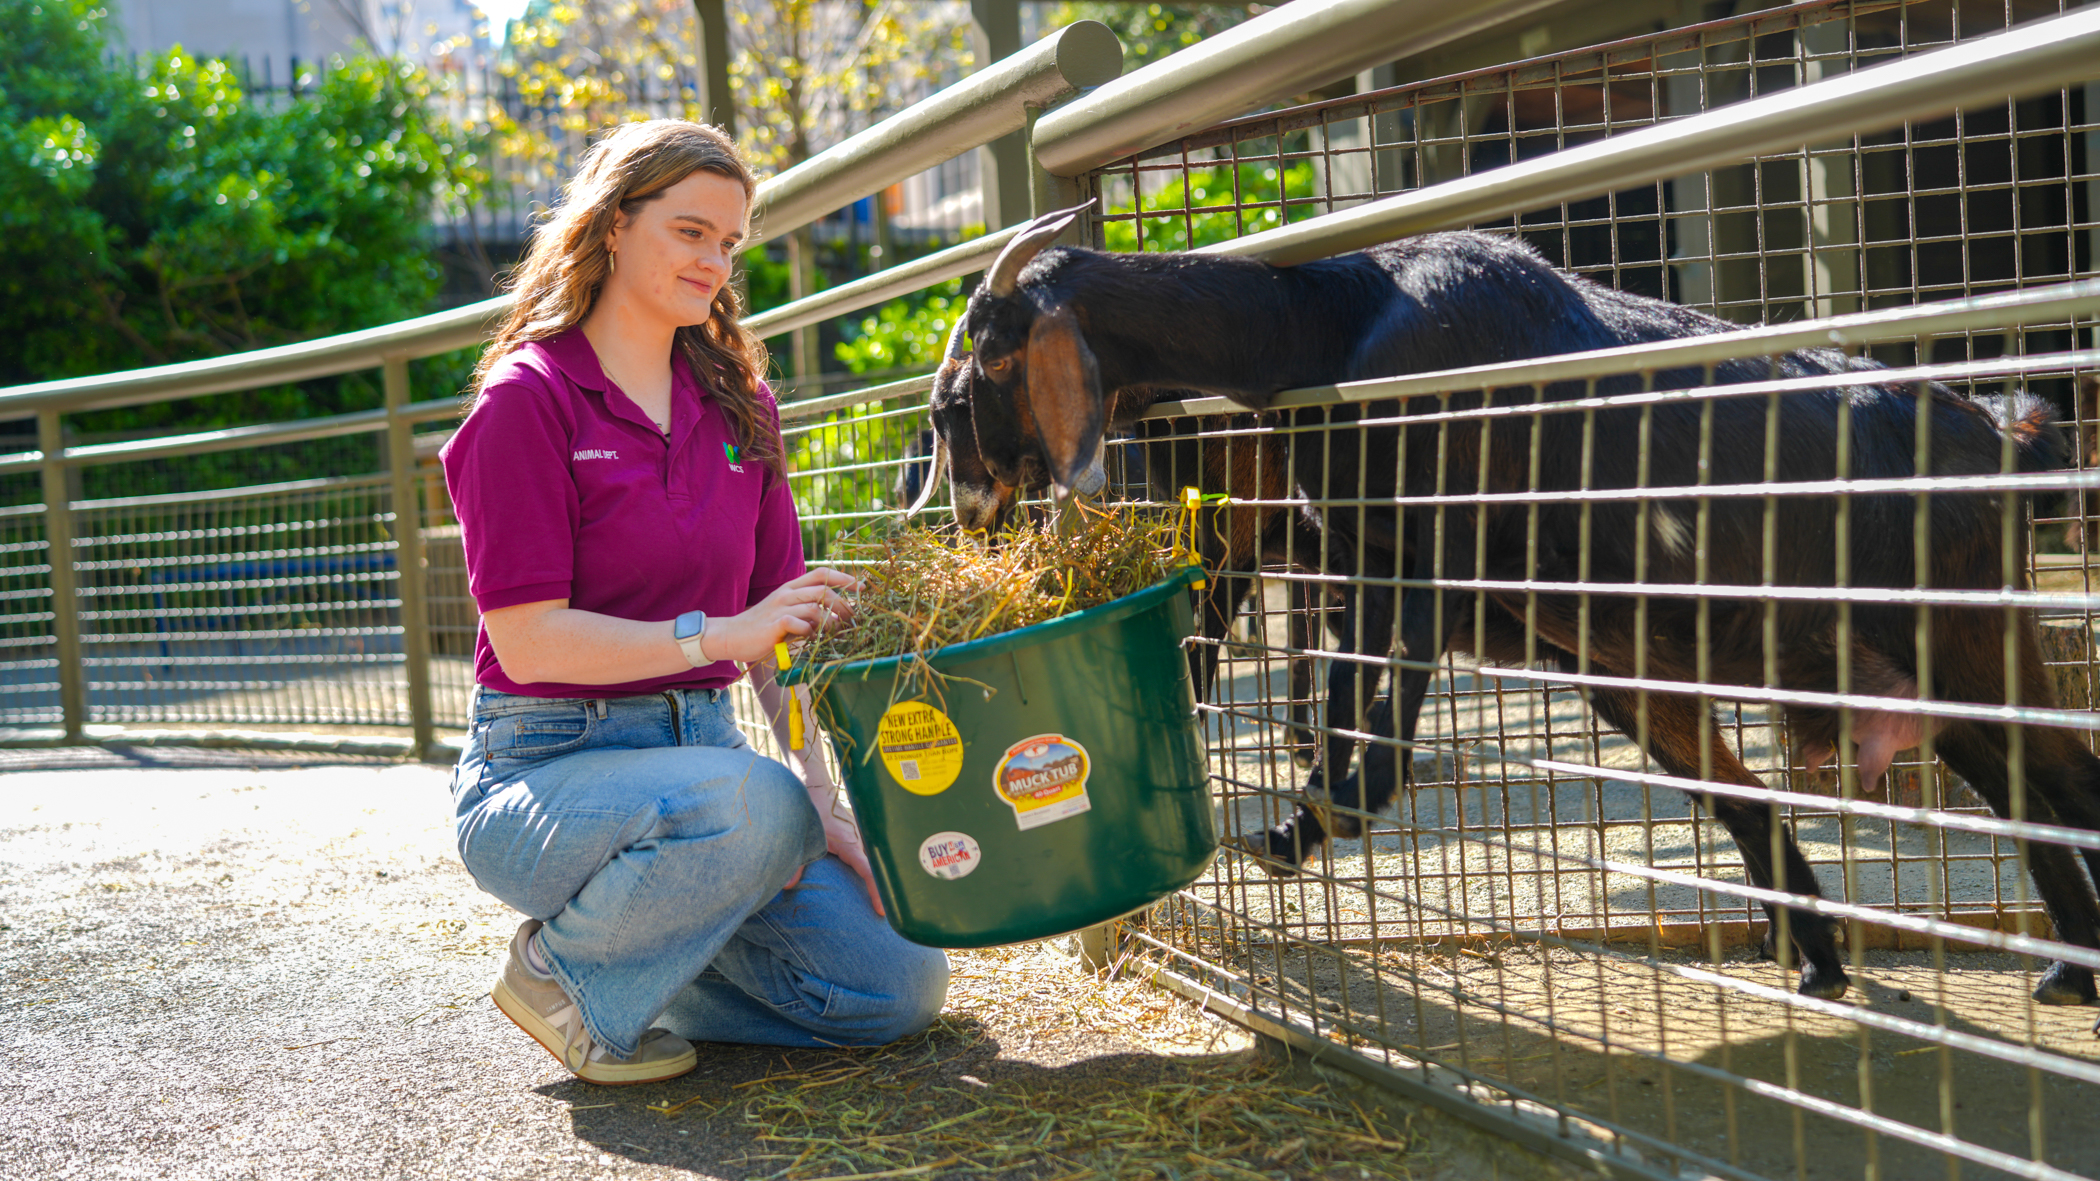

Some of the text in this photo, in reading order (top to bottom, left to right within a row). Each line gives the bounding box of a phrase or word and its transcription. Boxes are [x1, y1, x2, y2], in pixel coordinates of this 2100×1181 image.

[573, 449, 603, 461] ANIMAL
[728, 464, 744, 473] WCS
[887, 709, 935, 728] NEW EXTRA
[881, 728, 913, 744] STRONG
[1010, 773, 1050, 792] MUCK
[1050, 763, 1078, 780] TUB
[1044, 786, 1061, 796] Quart
[928, 842, 948, 858] BUY
[546, 999, 566, 1013] CAMPUS
